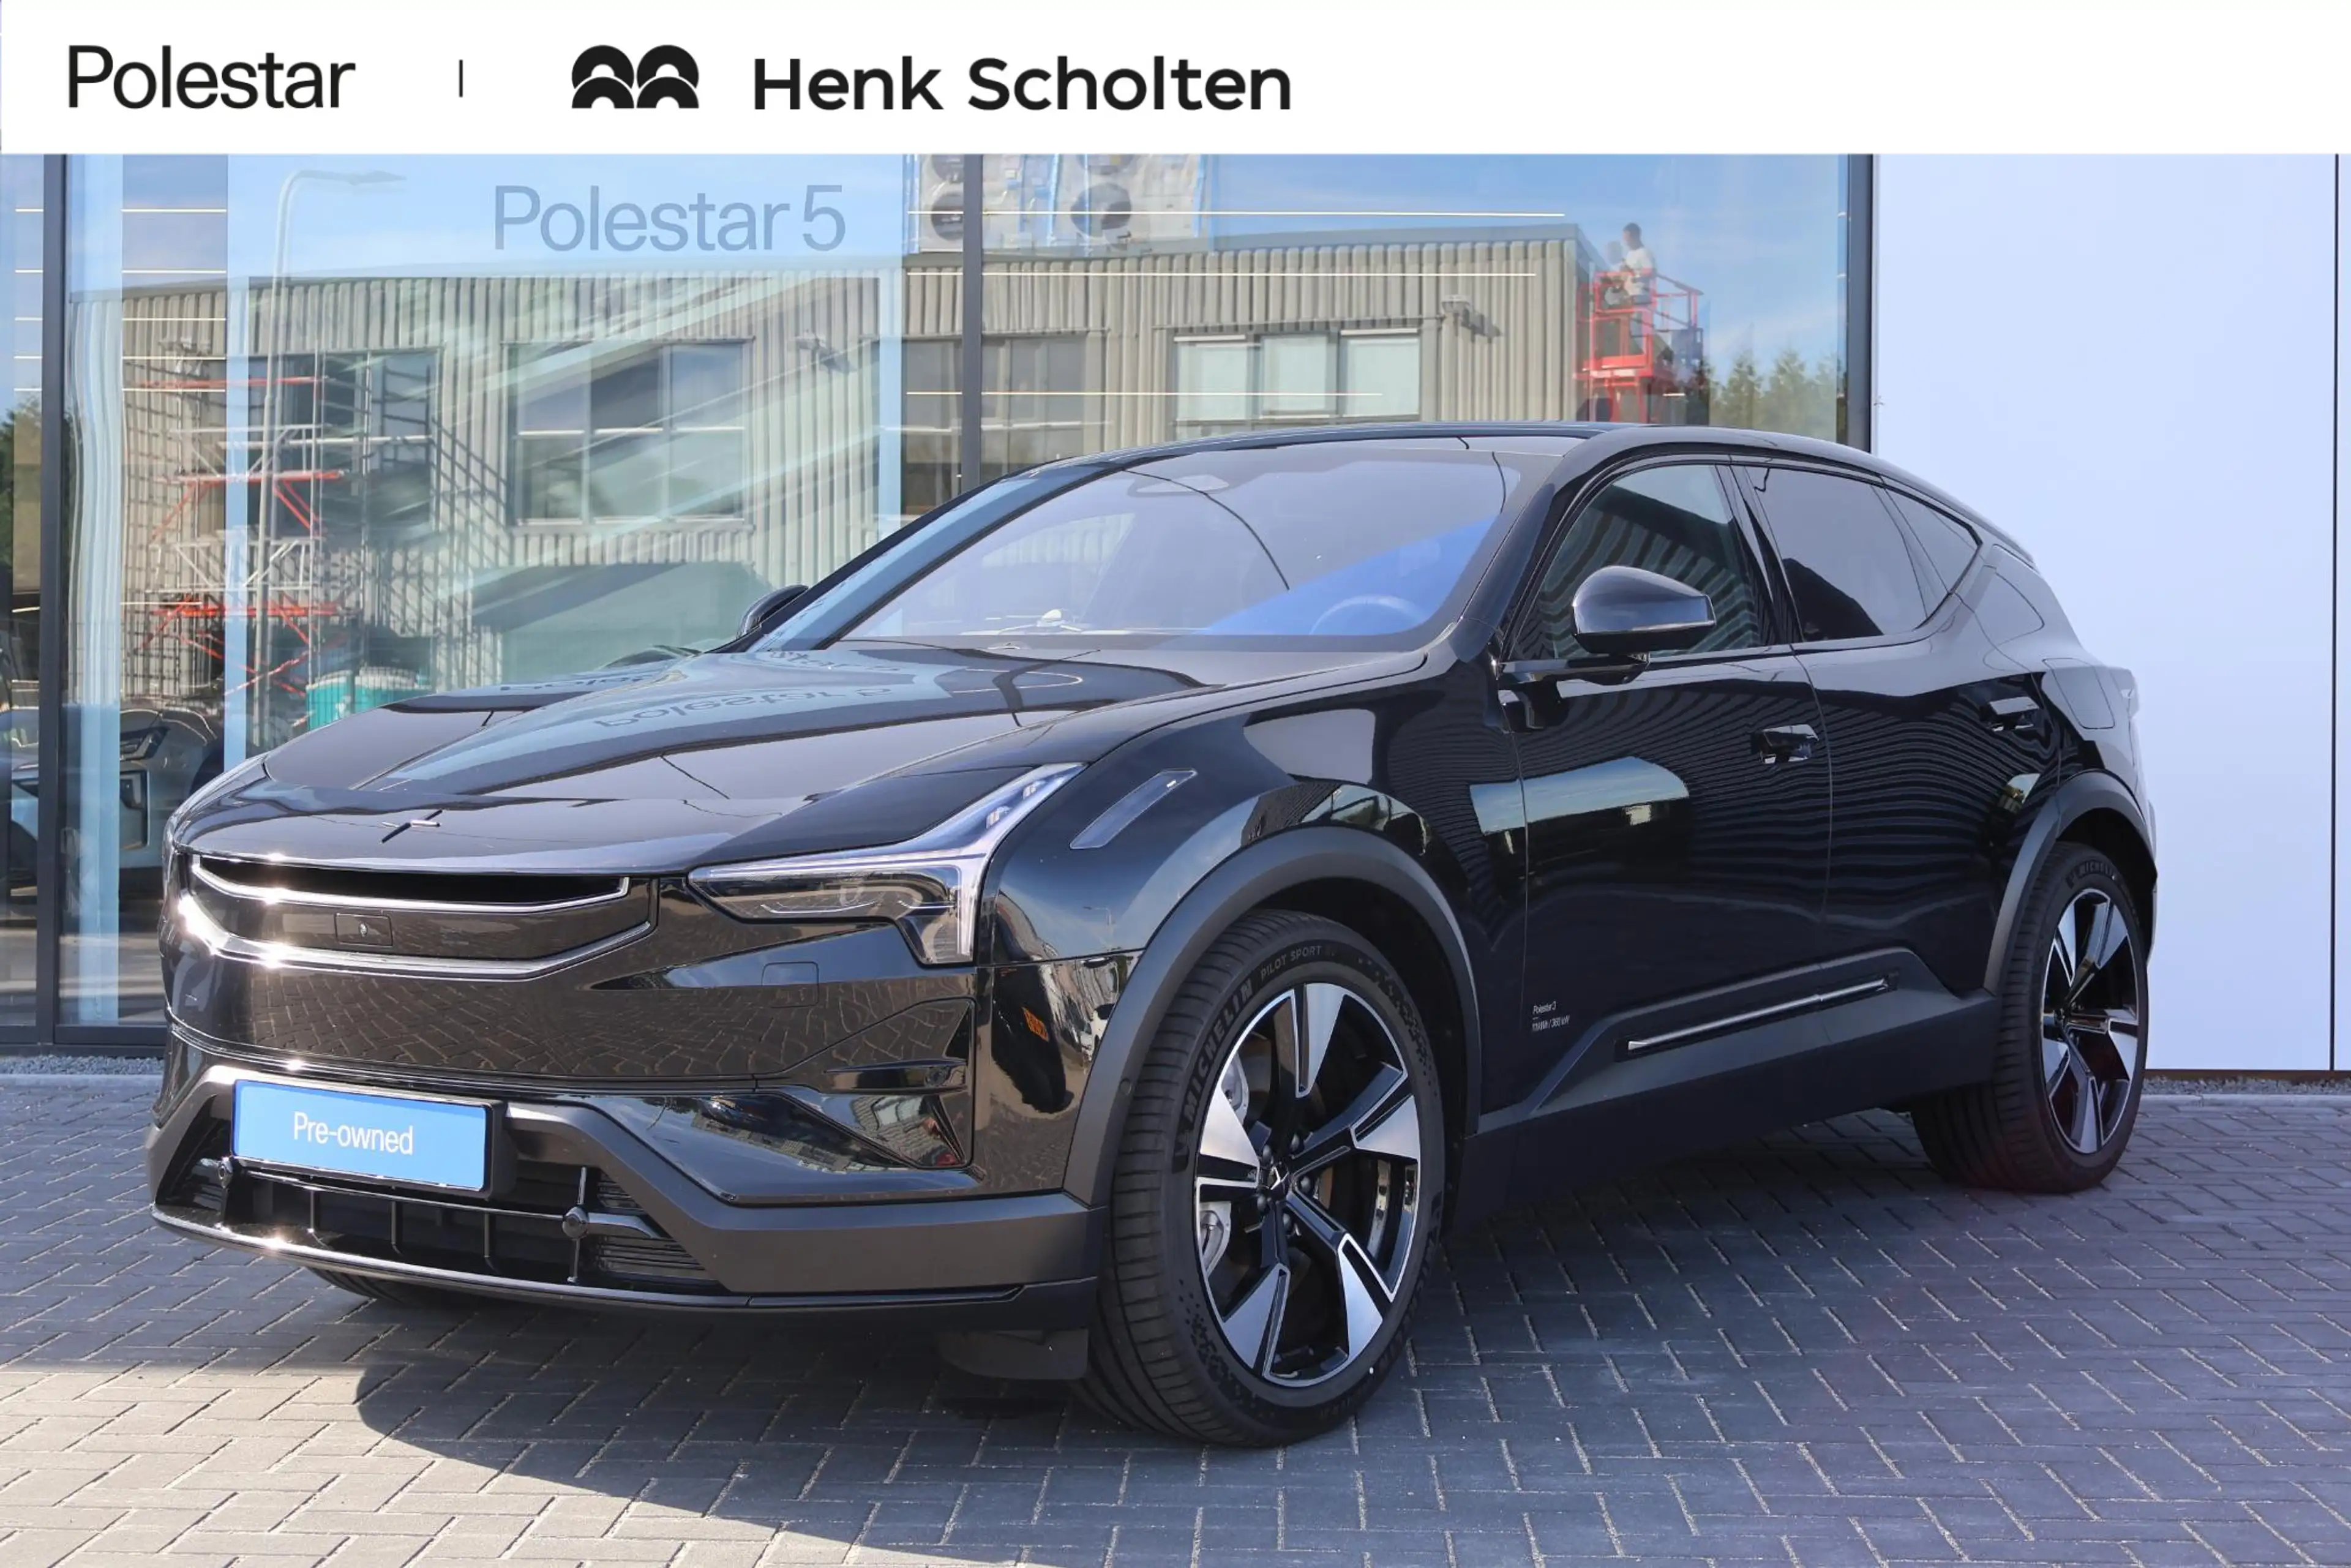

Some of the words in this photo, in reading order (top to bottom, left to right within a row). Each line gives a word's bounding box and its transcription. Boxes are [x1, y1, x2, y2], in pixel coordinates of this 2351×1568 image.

[495, 185, 790, 252] Polestar
[803, 185, 846, 252] 5
[1183, 980, 1253, 1120] MICHELIN
[1261, 954, 1287, 981] PILOT
[1290, 946, 1322, 962] SPORT
[294, 1111, 413, 1155] Pre-owned
